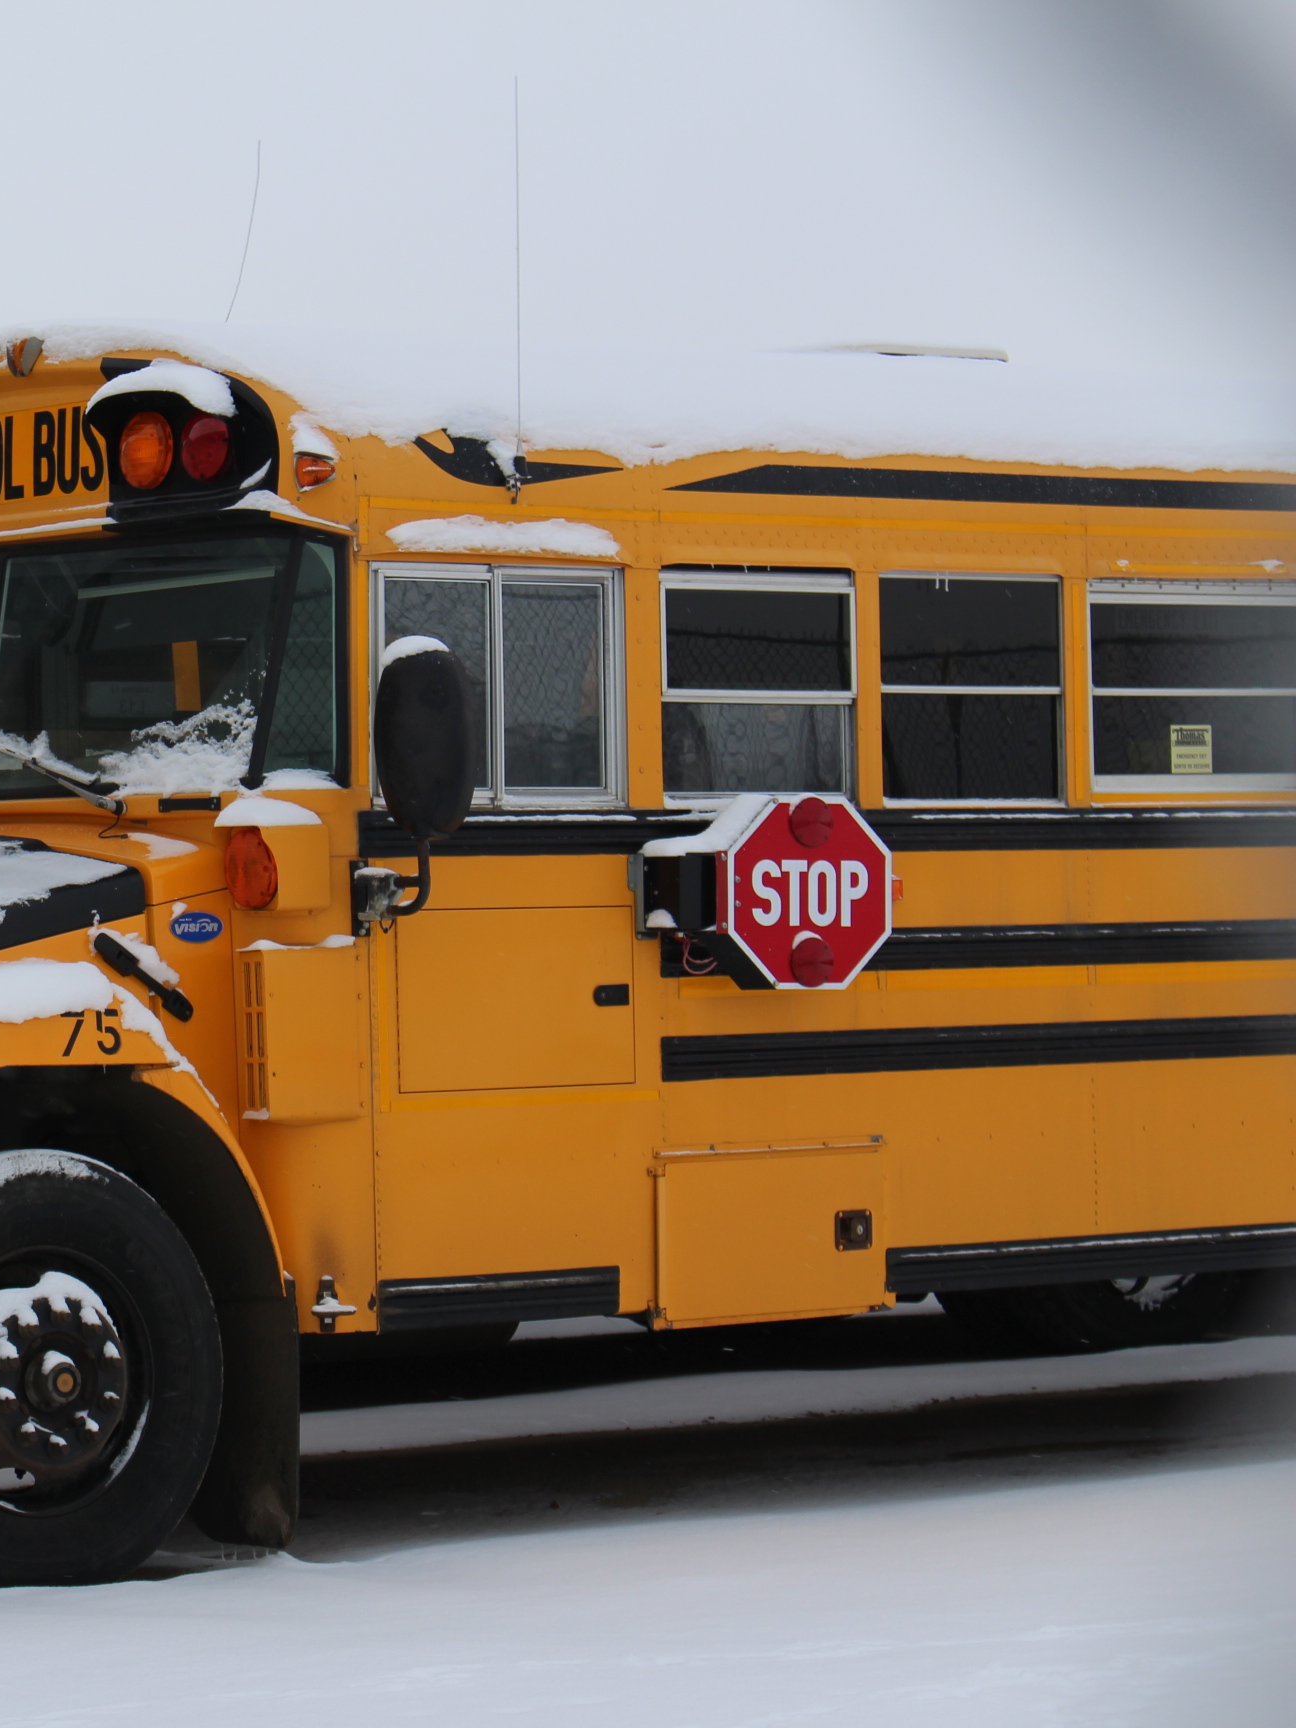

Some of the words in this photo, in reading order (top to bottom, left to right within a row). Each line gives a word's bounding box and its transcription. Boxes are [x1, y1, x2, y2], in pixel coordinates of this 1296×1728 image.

[34, 406, 104, 497] BUS
[751, 859, 869, 927] STOP
[60, 1009, 121, 1057] 75
